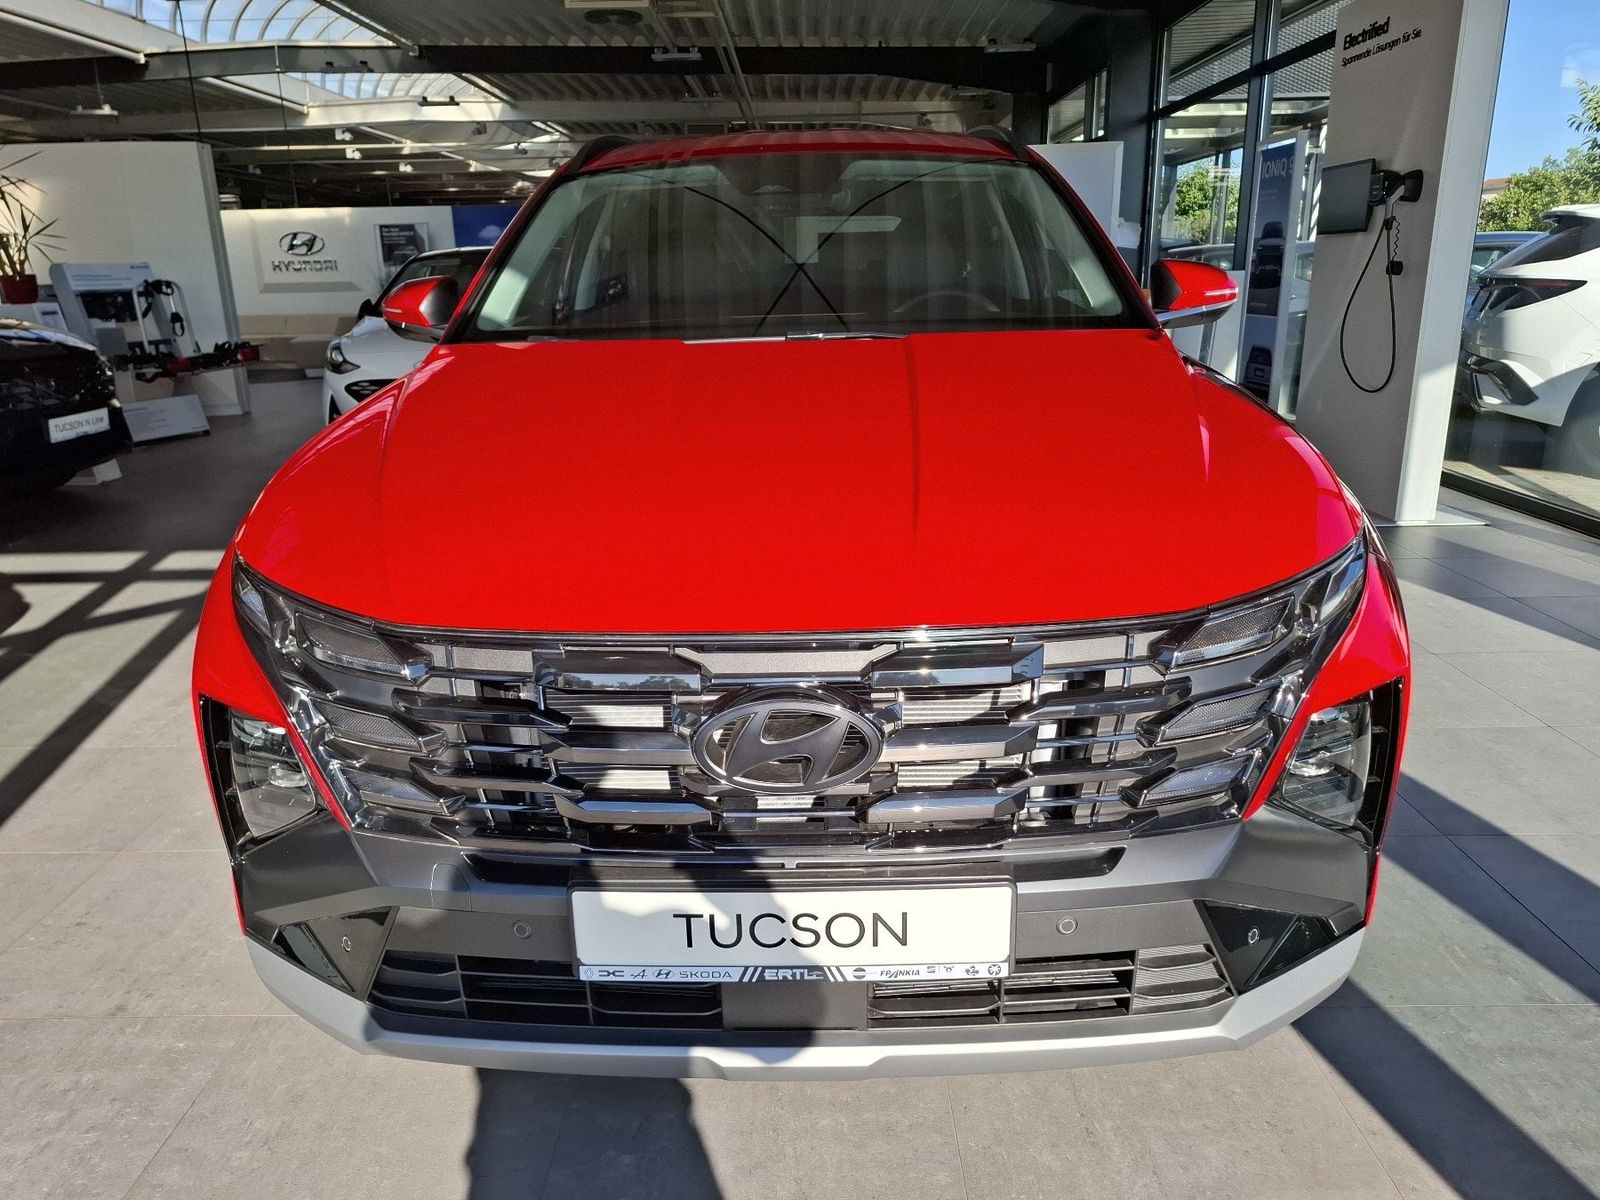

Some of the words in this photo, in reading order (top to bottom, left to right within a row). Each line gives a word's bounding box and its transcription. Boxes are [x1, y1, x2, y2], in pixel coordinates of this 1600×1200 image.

[1343, 16, 1391, 51] Electrified
[1341, 48, 1372, 68] Spannende
[1372, 37, 1402, 52] Lösungen
[1402, 31, 1411, 44] für
[1411, 27, 1422, 40] Sie
[1262, 157, 1287, 178] IONIQ
[271, 260, 339, 272] HYUNDAI
[54, 419, 84, 433] TUCSON
[85, 418, 91, 426] N
[672, 912, 908, 949] TUCSON
[763, 968, 818, 981] ERTL
[879, 968, 921, 979] FRANKIA
